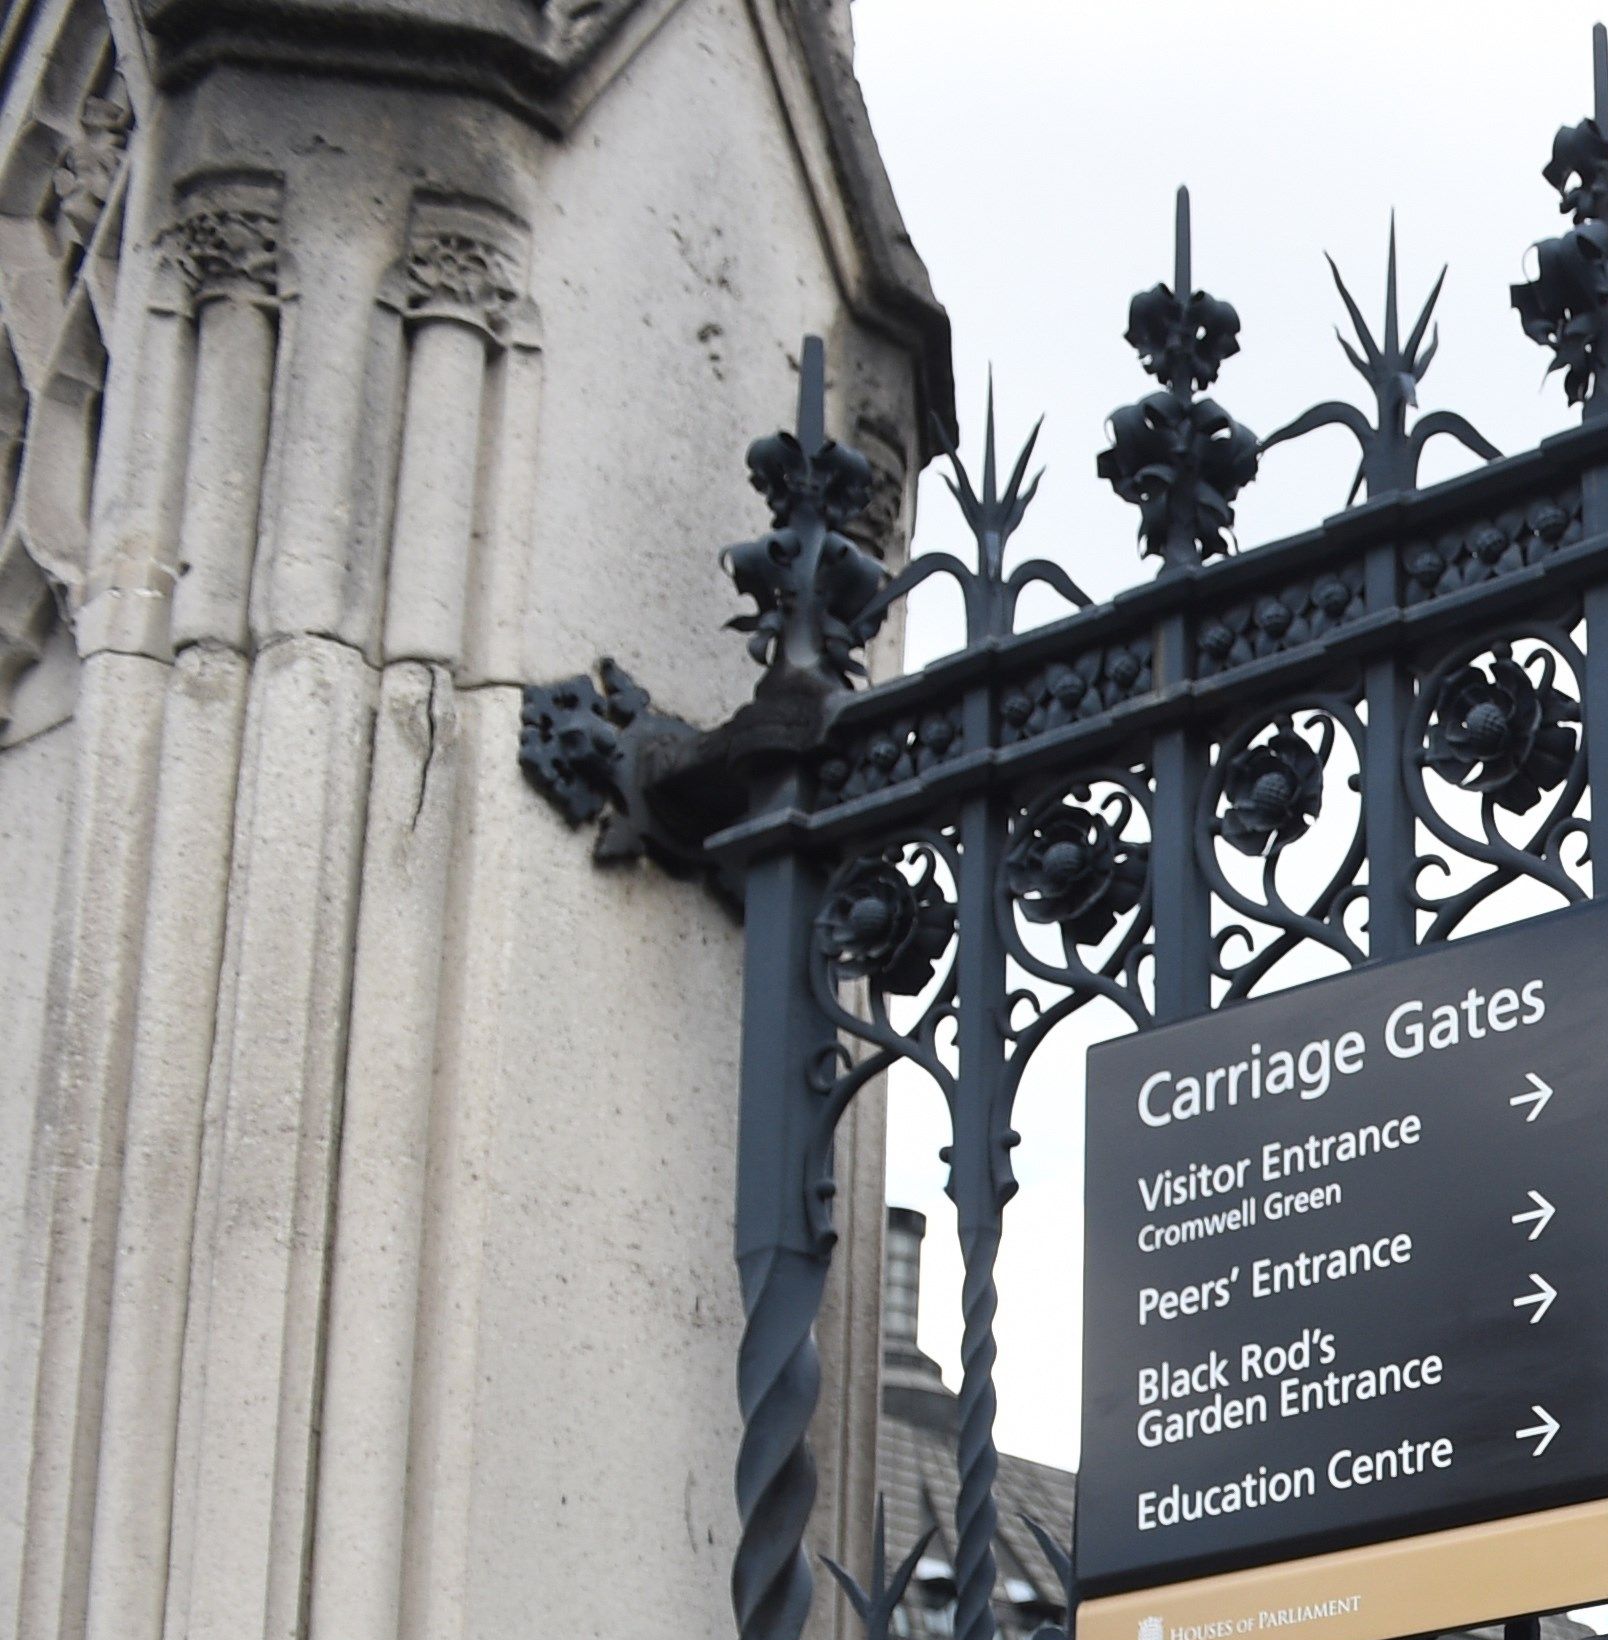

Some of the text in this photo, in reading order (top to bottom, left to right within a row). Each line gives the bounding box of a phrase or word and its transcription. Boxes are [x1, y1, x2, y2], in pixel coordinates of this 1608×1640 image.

[1137, 978, 1546, 1127] Carriage Gates
[1137, 1114, 1422, 1212] Visitor Entrance
[1137, 1183, 1342, 1253] Cromwell Green
[1138, 1233, 1413, 1326] Peers' Entrance
[1137, 1354, 1443, 1448] Garden Entrance
[1138, 1328, 1336, 1406] Black Rod's
[1138, 1437, 1454, 1531] Education Centre
[1258, 1595, 1362, 1631] PARLIAMENT
